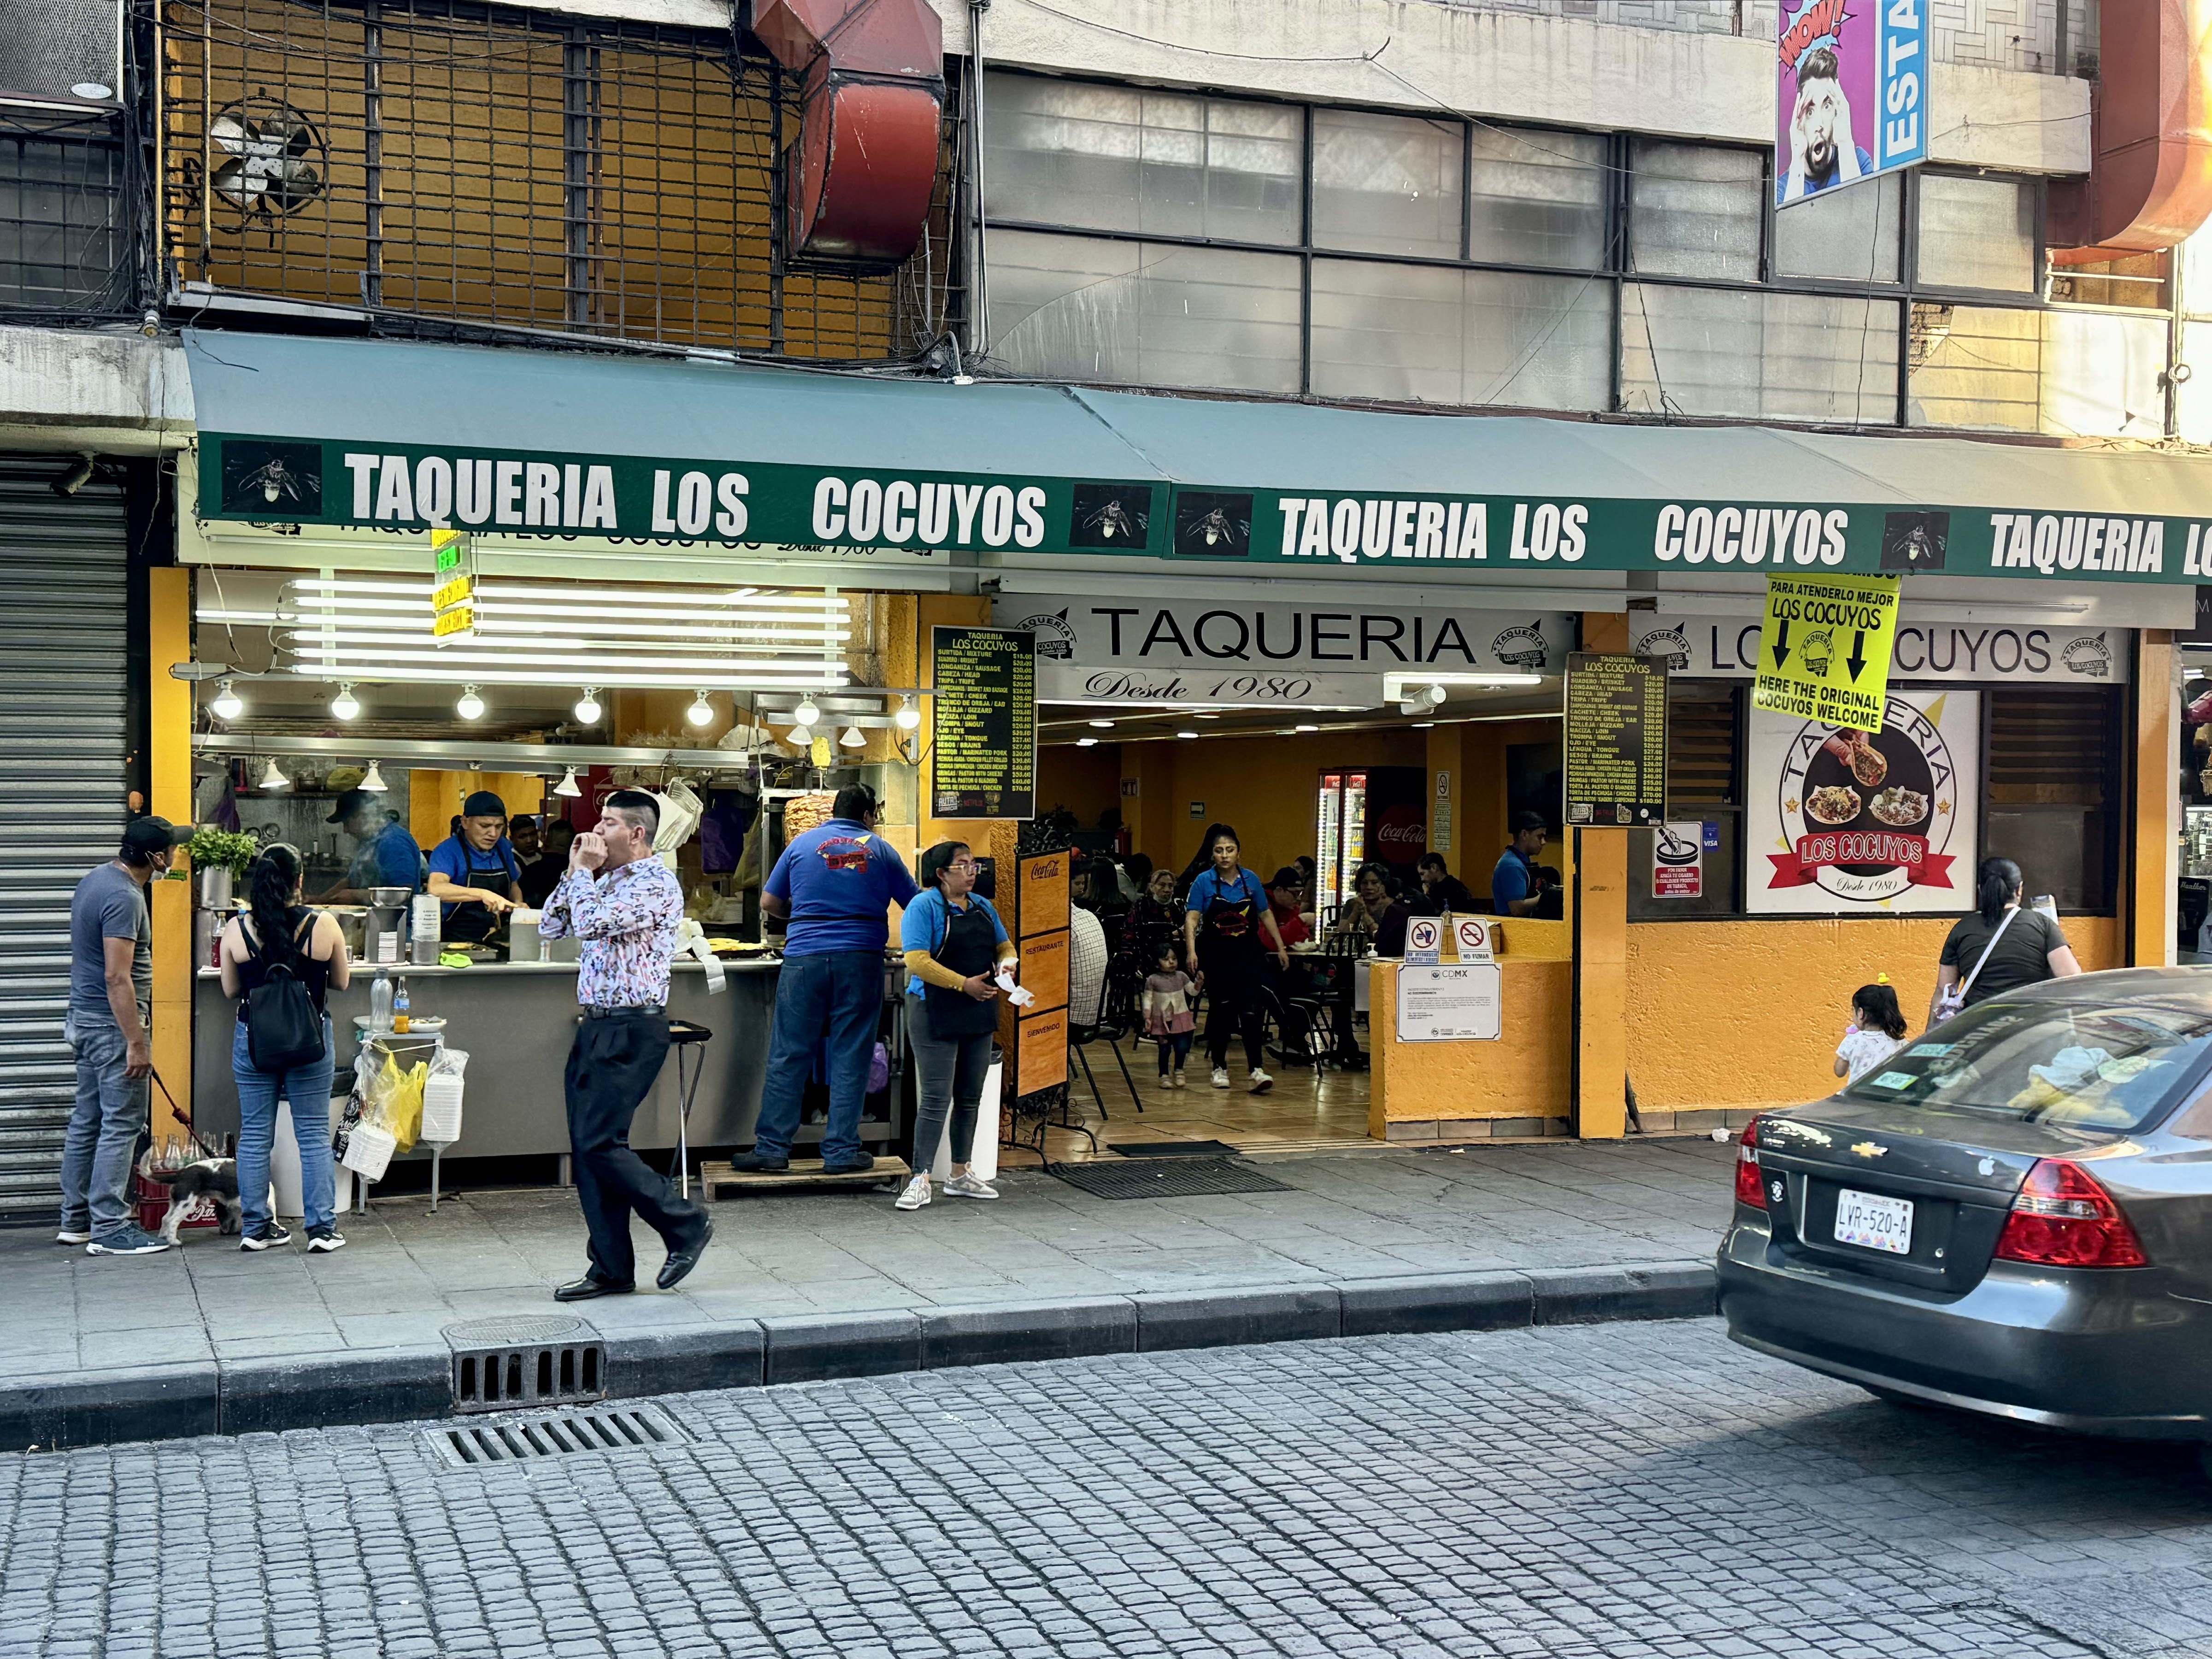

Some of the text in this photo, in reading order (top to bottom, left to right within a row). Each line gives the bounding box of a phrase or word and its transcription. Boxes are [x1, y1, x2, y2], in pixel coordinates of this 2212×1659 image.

[1887, 0, 1919, 158] ESTA
[344, 453, 1046, 548] TAQUERIA LOS COCUYOS
[1279, 498, 1848, 566] TAQUERIA LOS COCUYOS
[1991, 514, 2164, 574] TAQUERIA
[1771, 582, 1894, 606] PARA ATENDERLO MEJOR
[1772, 598, 1881, 630] LOS COCUYOS
[1018, 617, 1071, 640] AQUERIA
[1091, 608, 1477, 665] TAQUERIA
[1496, 629, 1543, 647] TAQUERIA
[1641, 632, 1686, 649] TAQUERIA
[953, 638, 1018, 651] LOS COCUYOS
[1038, 641, 1066, 650] COCUYOS
[1712, 625, 2051, 673] LO CUYOS
[1803, 634, 1832, 654] TAQUERIA
[2065, 640, 2106, 657] TAQUERIA
[1585, 662, 1650, 674] LOS COCUYOS
[1081, 671, 1312, 699] Desde 1980
[1759, 675, 1879, 711] HERE THE ORIGINAL
[1758, 693, 1877, 728] COCUYOS WELCOME
[1784, 700, 1951, 790] TAERIA
[1801, 834, 1922, 863] LOS COCUYOS
[1836, 877, 1898, 891] Desde 1980
[1026, 941, 1064, 954] RESTAURANTE
[1027, 1023, 1060, 1037] BIENVENIDO
